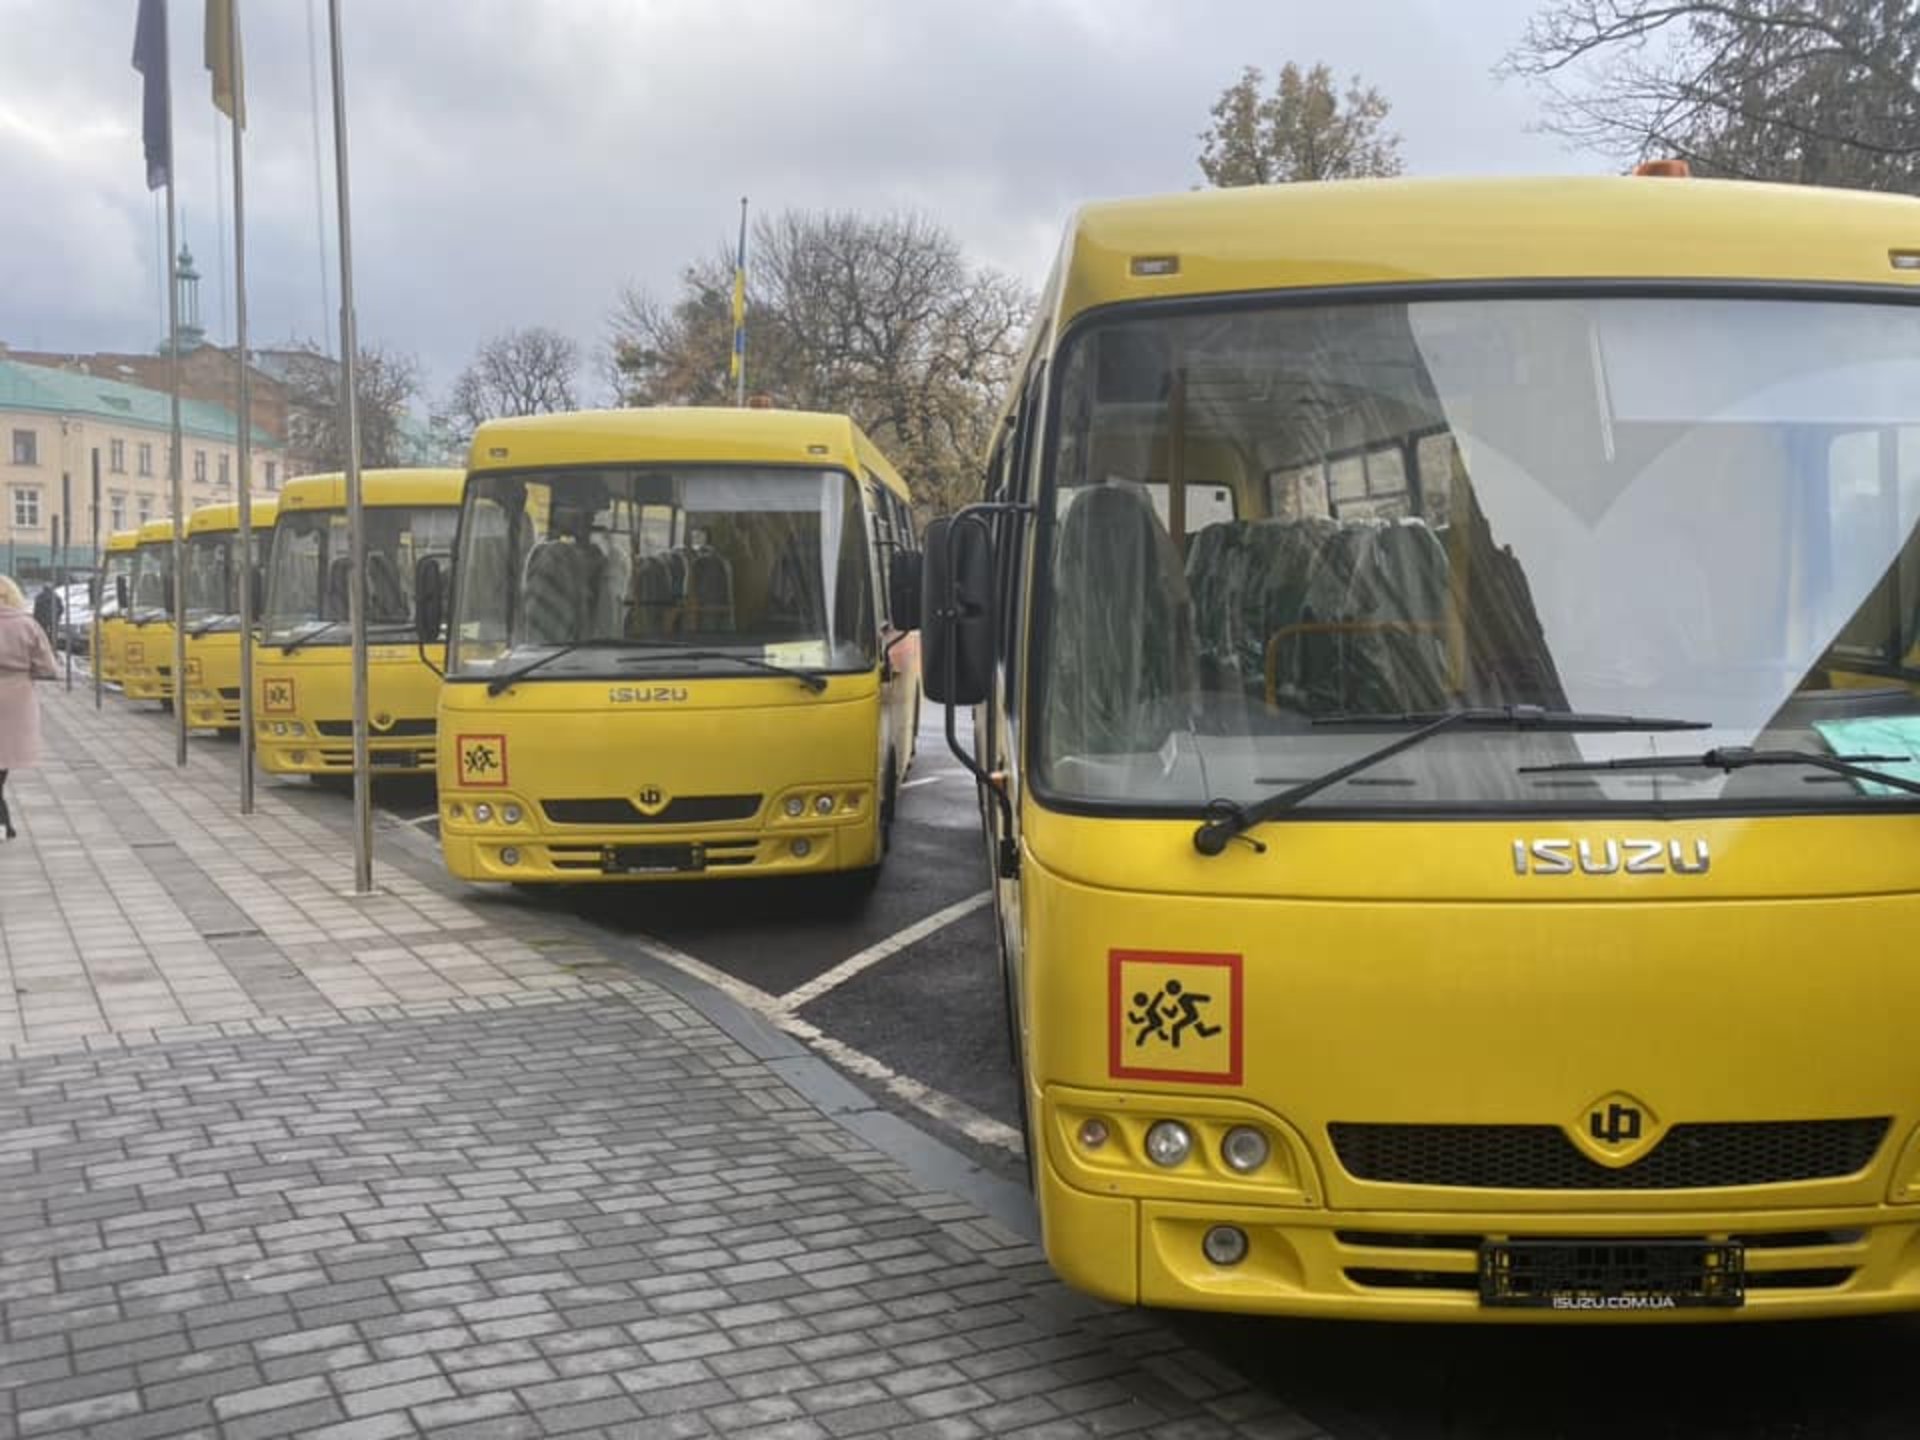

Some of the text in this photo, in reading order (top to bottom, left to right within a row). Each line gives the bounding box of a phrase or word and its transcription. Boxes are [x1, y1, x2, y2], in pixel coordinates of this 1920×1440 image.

[609, 687, 688, 703] ISUZU
[1513, 838, 1710, 875] ISUZU
[1553, 1296, 1676, 1310] ISUZU.COM.UA
